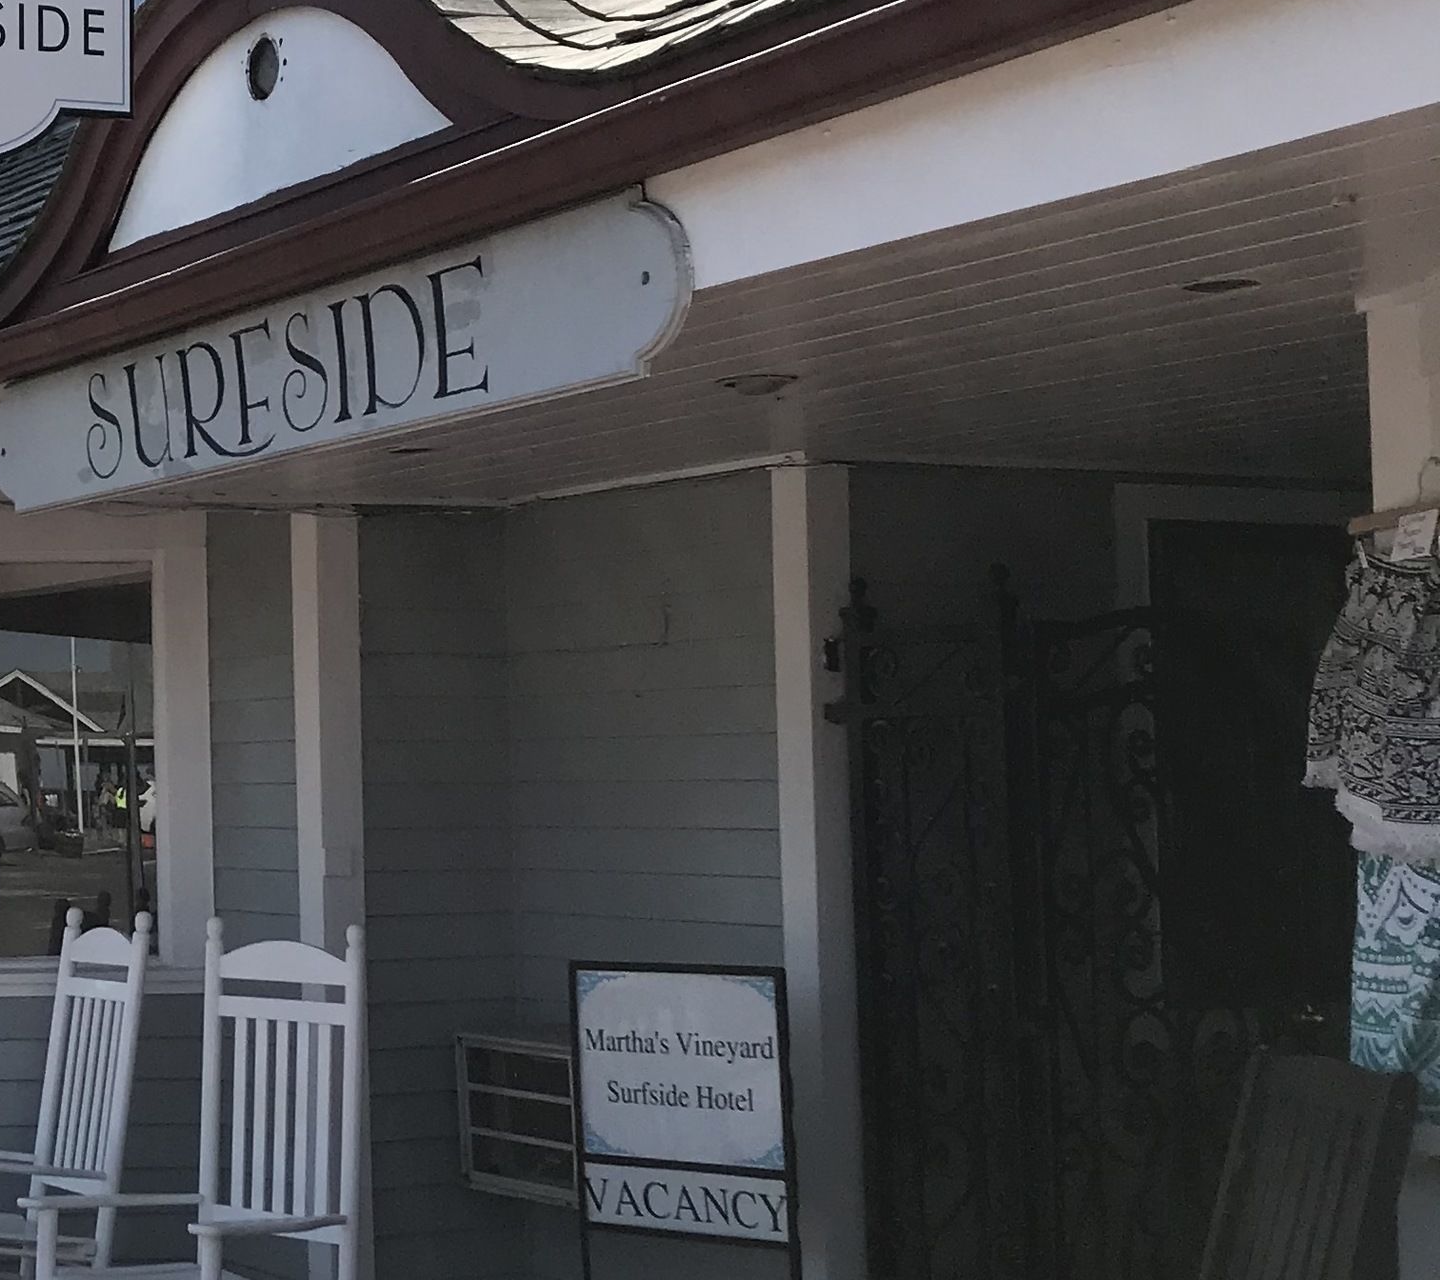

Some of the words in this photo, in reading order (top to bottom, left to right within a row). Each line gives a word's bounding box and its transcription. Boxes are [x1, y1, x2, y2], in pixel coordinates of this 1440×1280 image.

[86, 256, 489, 479] SURFSIDE
[584, 1027, 670, 1054] Martha's
[675, 1032, 775, 1064] Vineyard
[606, 1079, 689, 1109] Surfside
[696, 1085, 754, 1113] Hotel
[584, 1176, 788, 1234] VACANCY
